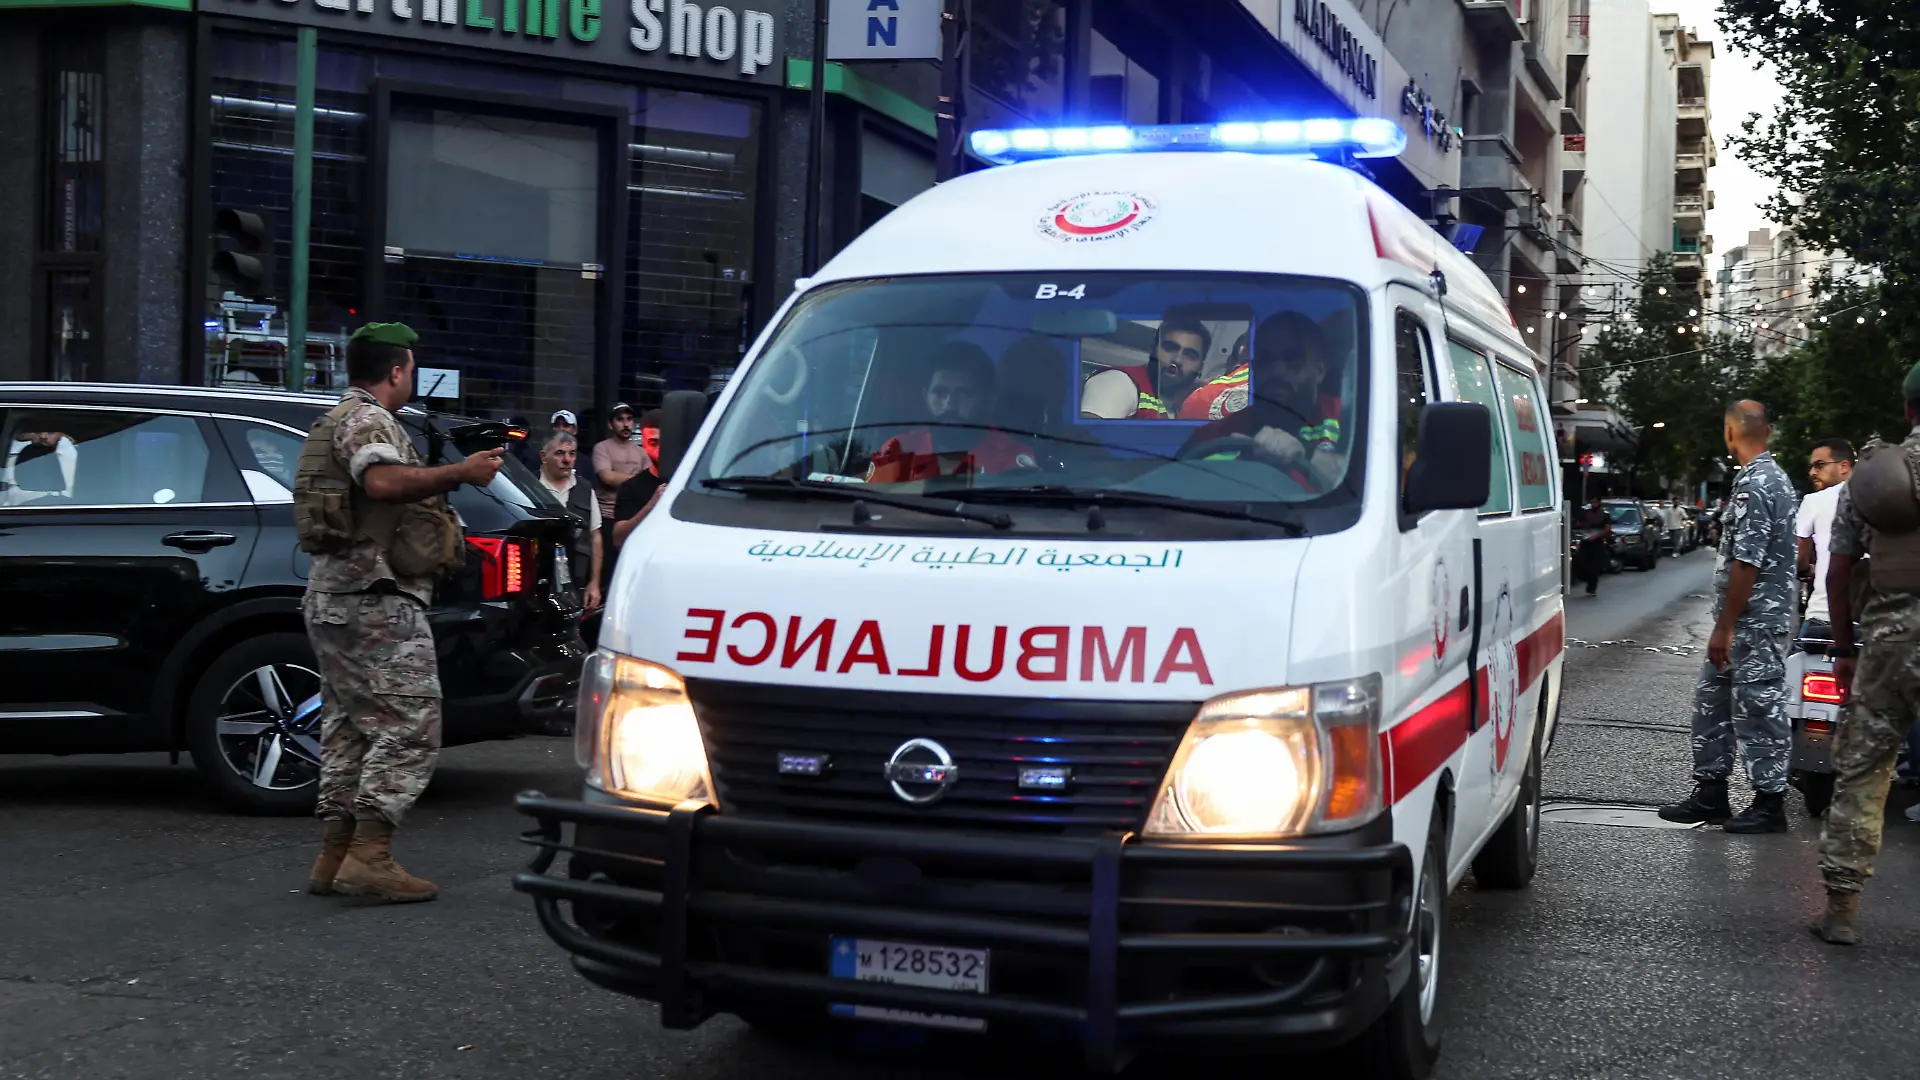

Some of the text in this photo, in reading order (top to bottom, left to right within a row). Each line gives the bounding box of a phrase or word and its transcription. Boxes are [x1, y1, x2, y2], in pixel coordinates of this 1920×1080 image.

[629, 0, 774, 75] Shop
[1035, 284, 1086, 299] B-4
[748, 538, 1183, 573] الجمعية الطبية الإسلامية
[879, 946, 979, 979] 128532
